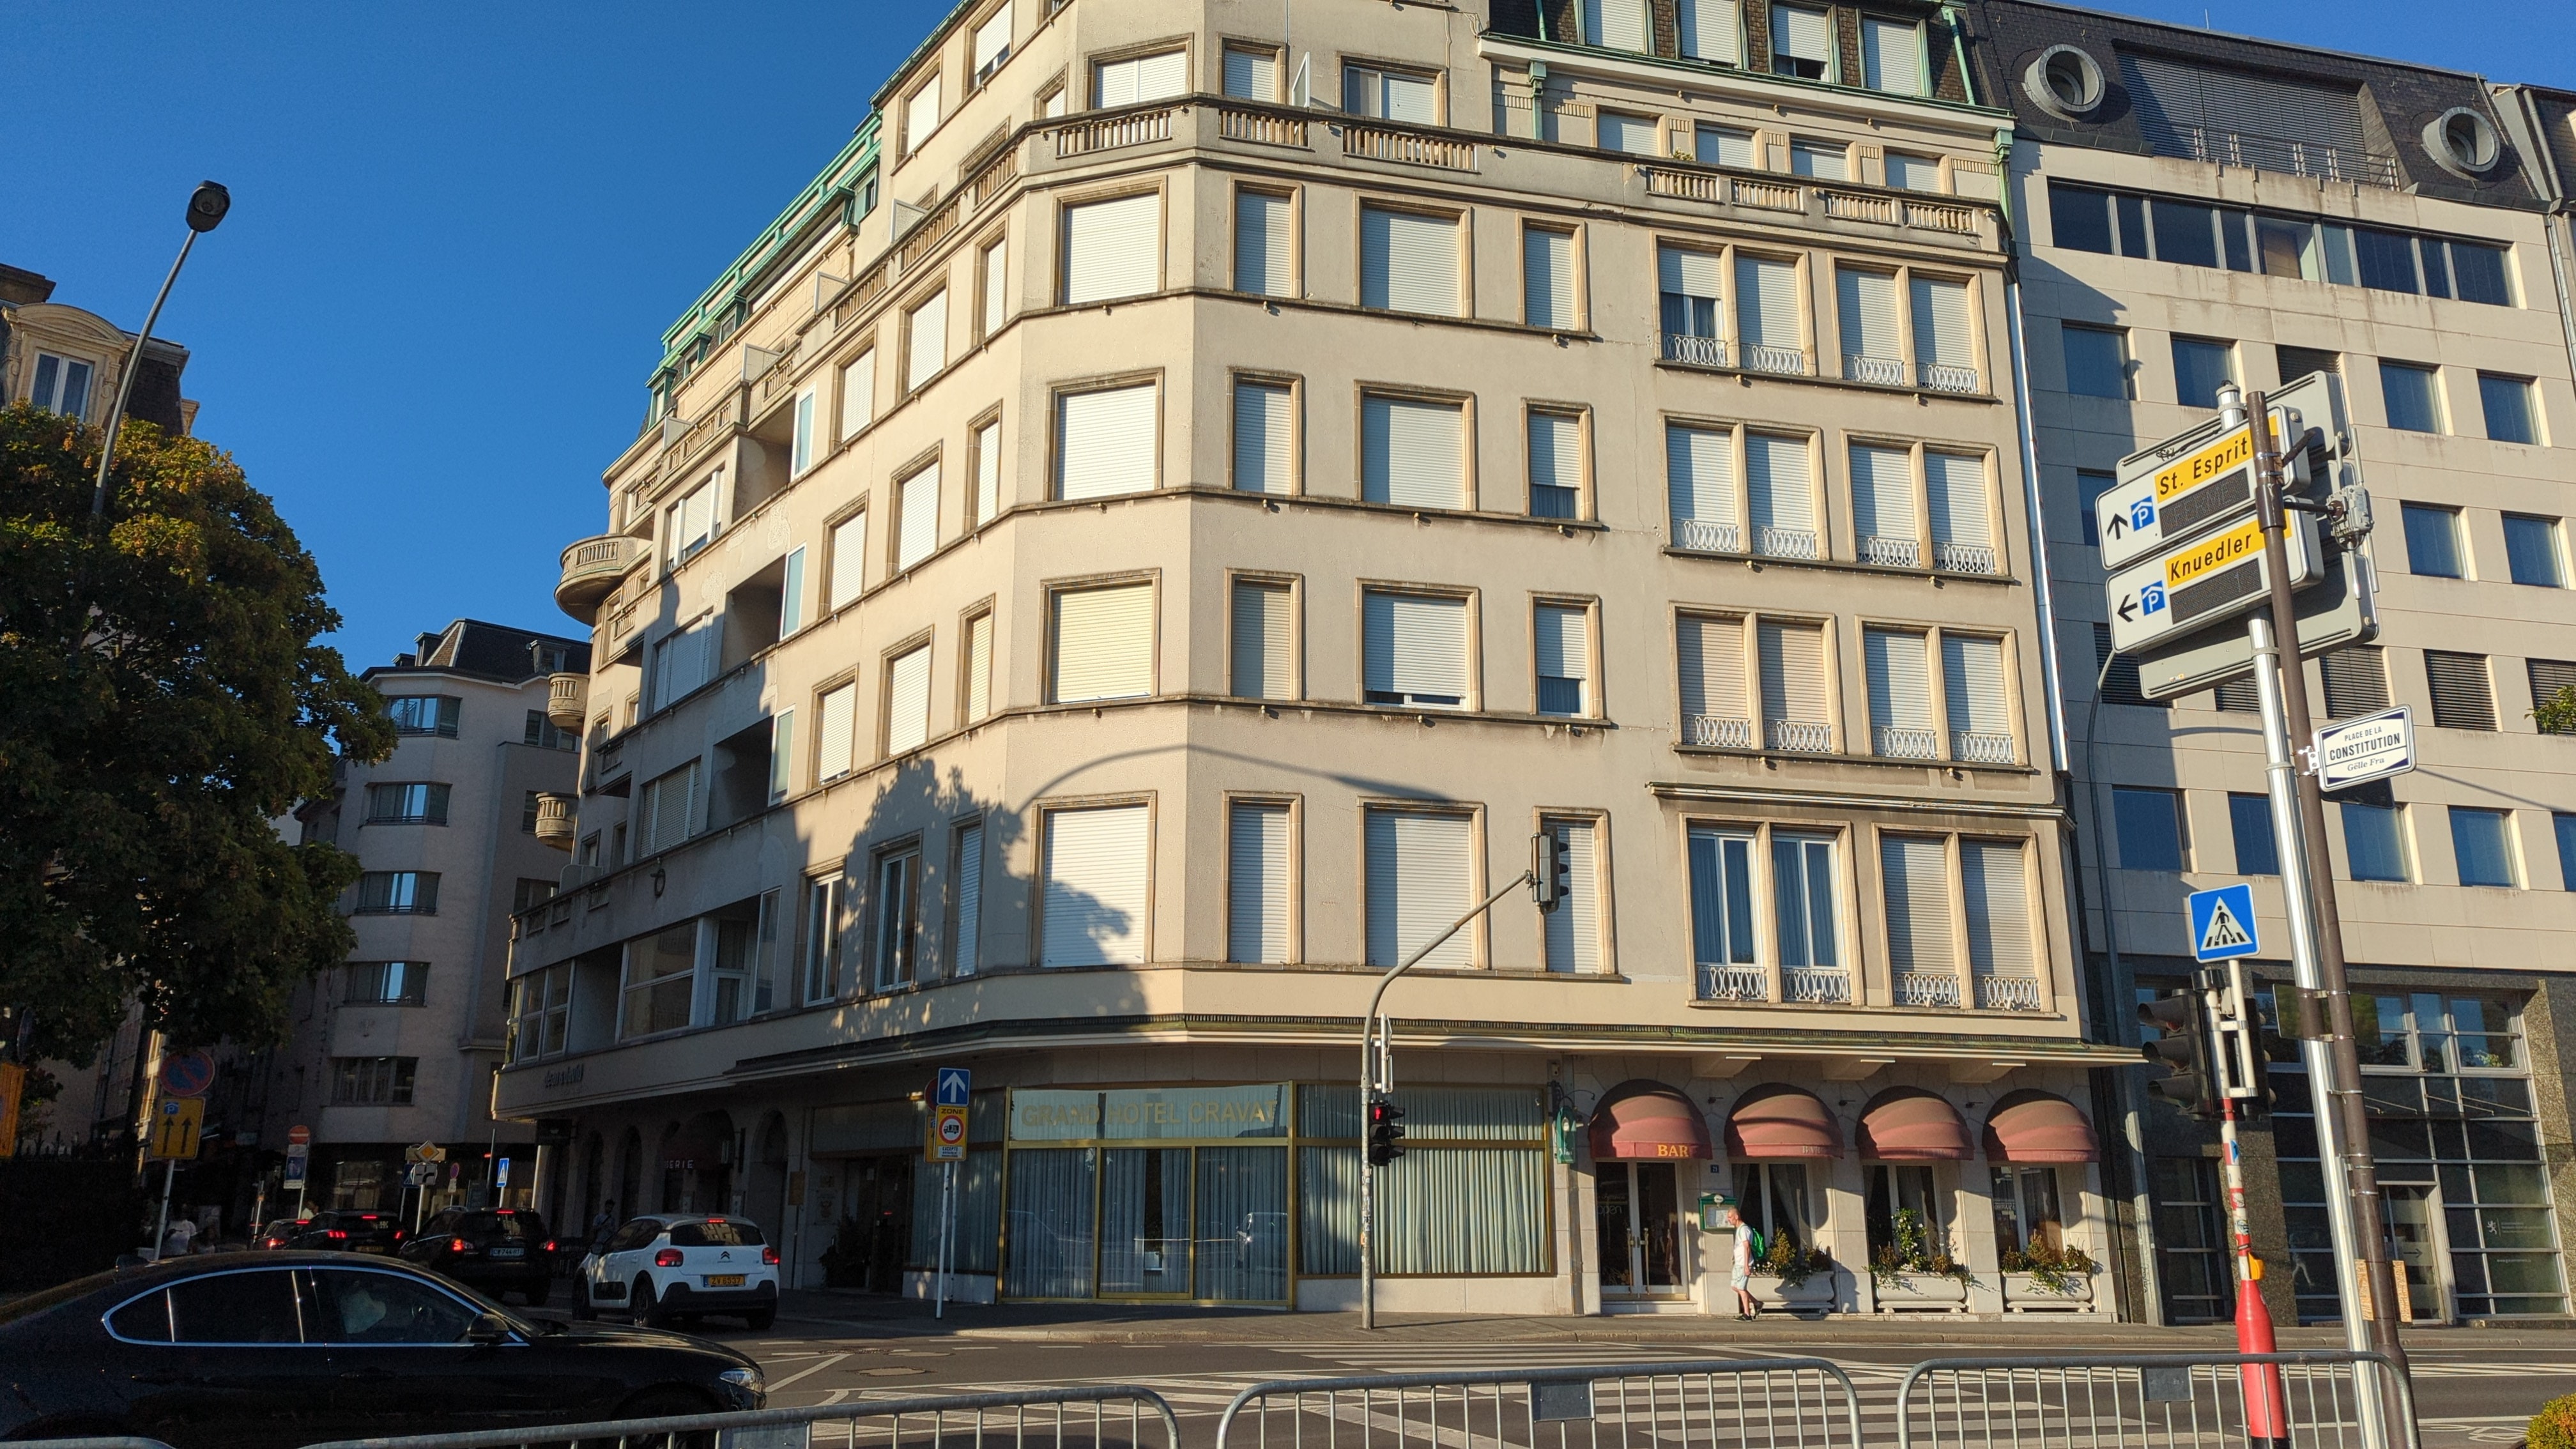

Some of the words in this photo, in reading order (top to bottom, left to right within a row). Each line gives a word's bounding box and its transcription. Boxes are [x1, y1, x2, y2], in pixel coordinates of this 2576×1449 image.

[2159, 471, 2183, 496] St.
[2193, 437, 2248, 480] Esprit
[2170, 533, 2251, 581] Knuedler
[2329, 733, 2400, 760] CONSTITUTION
[2344, 731, 2363, 741] PLACE
[2347, 761, 2368, 771] Gëlle
[1023, 1104, 1100, 1126] GRAND
[1107, 1103, 1182, 1124] HOTEL
[1188, 1100, 1278, 1123] CRAVAT
[1657, 1144, 1689, 1158] BAR
